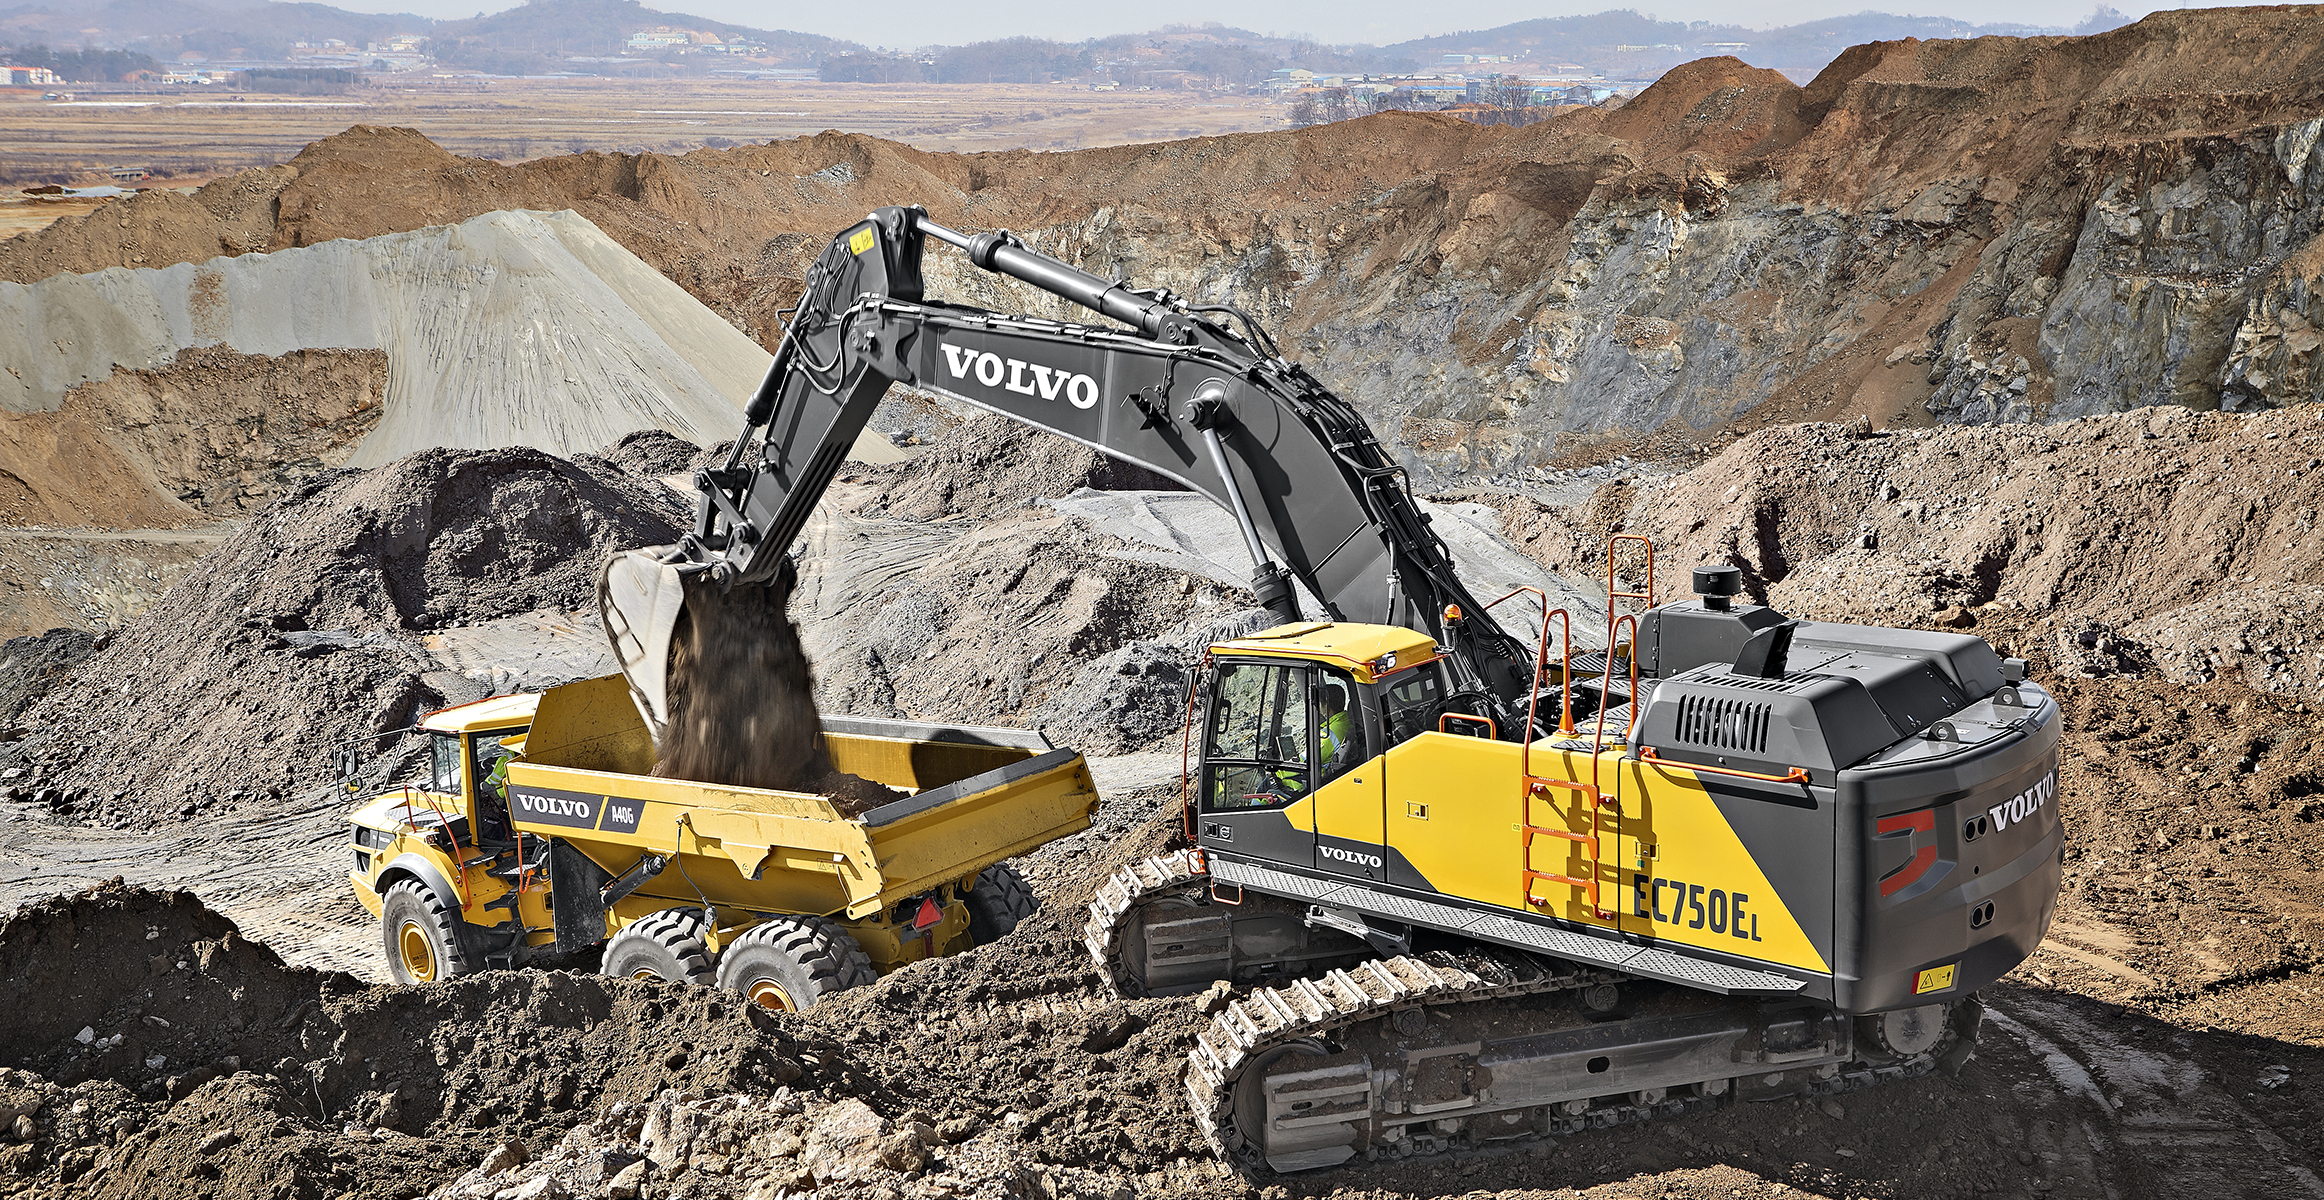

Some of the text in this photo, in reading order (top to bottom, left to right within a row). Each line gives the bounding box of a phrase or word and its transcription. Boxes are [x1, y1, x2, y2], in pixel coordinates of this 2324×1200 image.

[941, 342, 1100, 410] VOLVO
[516, 793, 635, 825] VOLVO A40G
[1989, 770, 2054, 832] VOLVO
[1318, 845, 1382, 868] VOLVO
